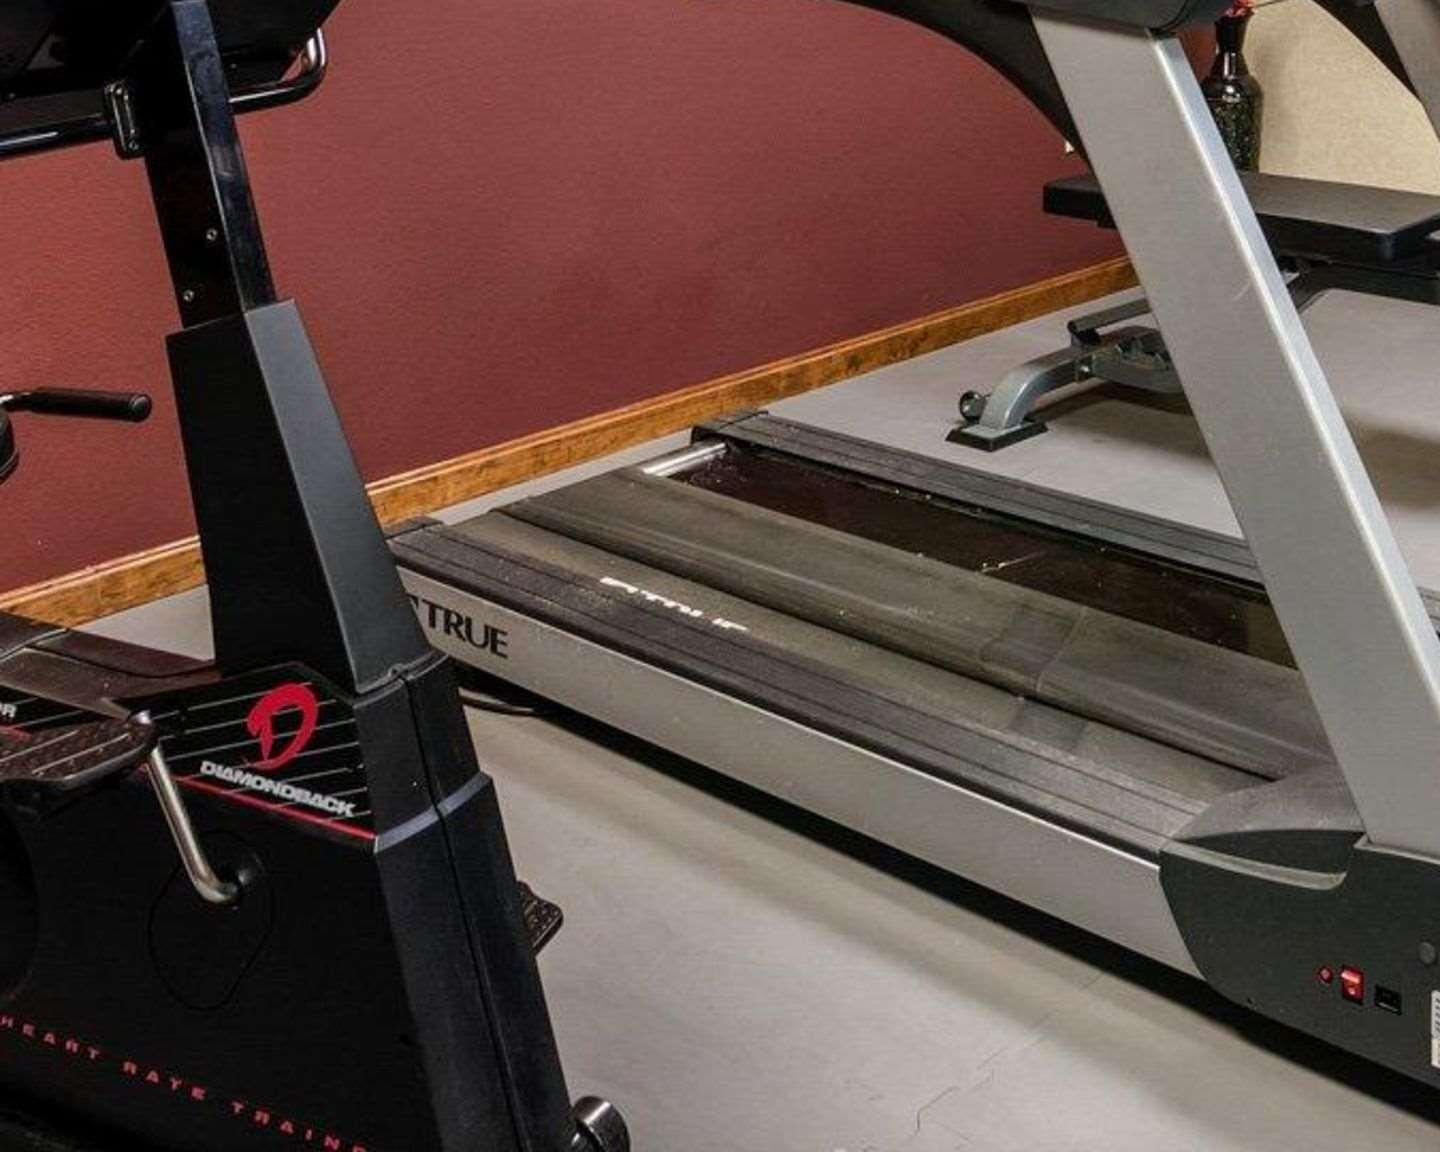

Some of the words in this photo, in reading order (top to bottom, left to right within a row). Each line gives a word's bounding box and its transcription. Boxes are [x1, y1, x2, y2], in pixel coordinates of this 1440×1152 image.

[422, 598, 508, 660] TRUE
[200, 760, 356, 817] DIAMONDBACK
[0, 1014, 100, 1061] HEART
[122, 1060, 206, 1101] RATE
